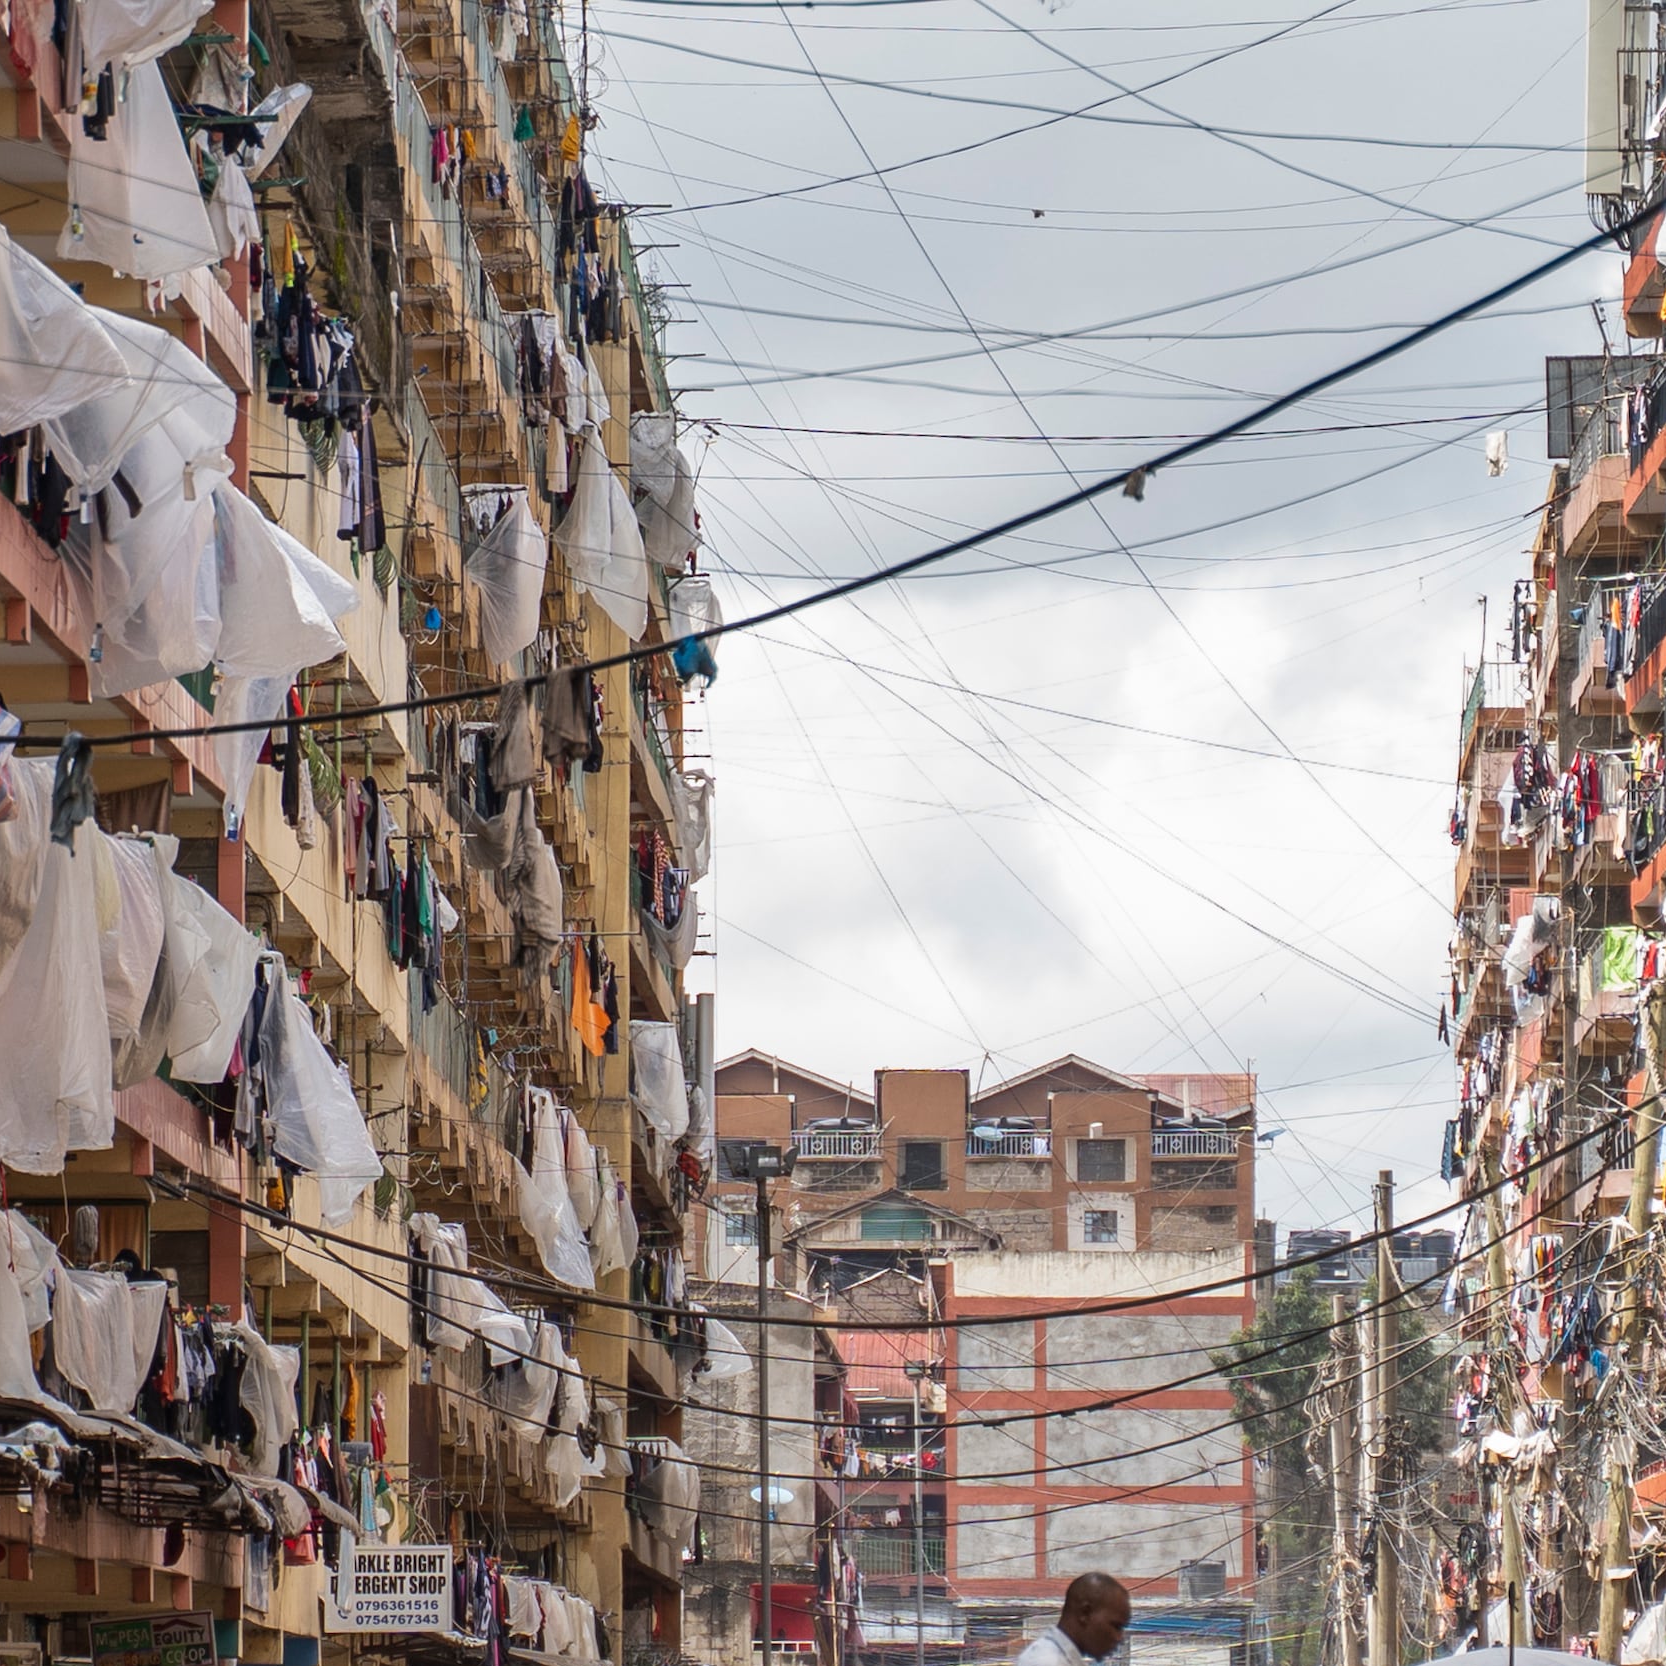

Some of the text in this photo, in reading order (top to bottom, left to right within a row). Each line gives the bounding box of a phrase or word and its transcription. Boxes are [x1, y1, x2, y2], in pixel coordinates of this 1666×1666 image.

[394, 1555, 445, 1573] BRIGHT
[409, 1576, 446, 1594] SHOP
[356, 1600, 439, 1611] 0796361516
[356, 1614, 439, 1625] 0754767343
[154, 1629, 206, 1646] EQUITY
